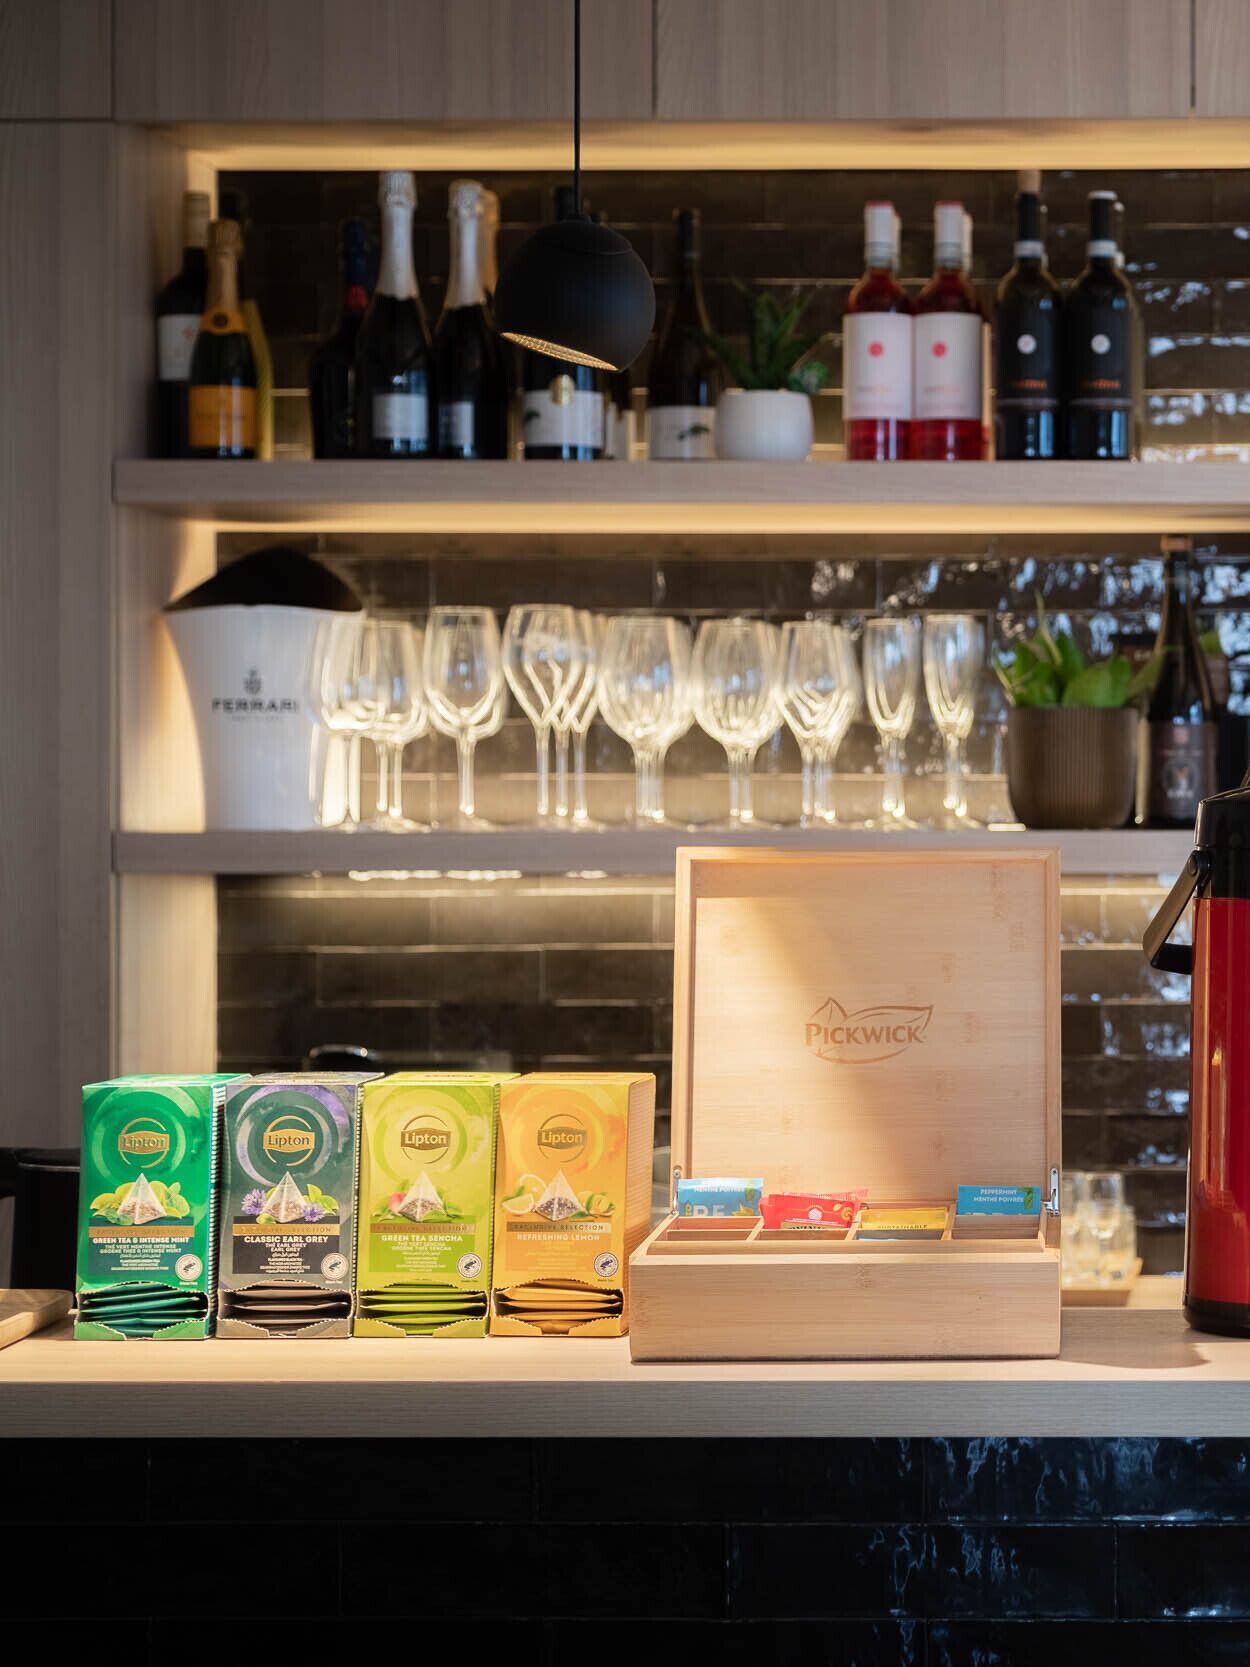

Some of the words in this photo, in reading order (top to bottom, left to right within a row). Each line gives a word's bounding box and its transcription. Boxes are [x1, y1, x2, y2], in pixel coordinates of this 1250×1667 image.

[211, 697, 297, 713] FERRARI
[124, 1137, 165, 1149] Lipton
[268, 1135, 309, 1149] Lipton
[404, 1133, 447, 1146] Lipton
[541, 1132, 583, 1145] Lipton
